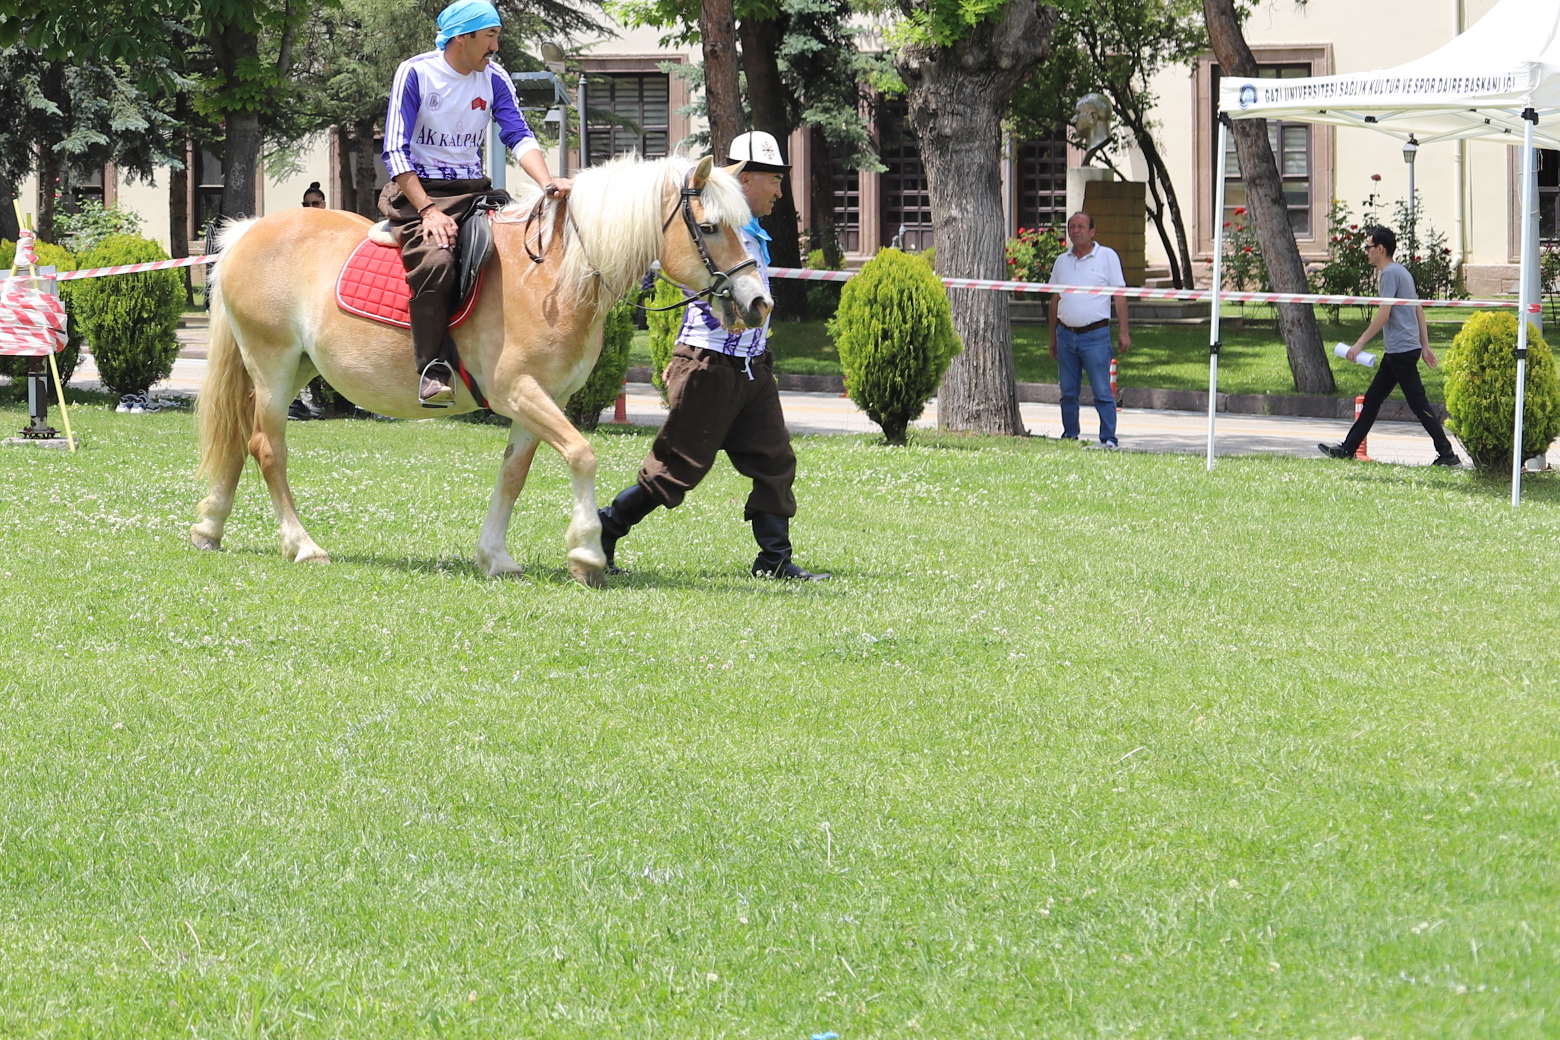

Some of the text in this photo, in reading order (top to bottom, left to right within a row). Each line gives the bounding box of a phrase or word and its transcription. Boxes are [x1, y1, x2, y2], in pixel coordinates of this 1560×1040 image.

[1402, 78, 1414, 94] VE
[1413, 78, 1436, 94] SPOR
[415, 124, 438, 146] AK
